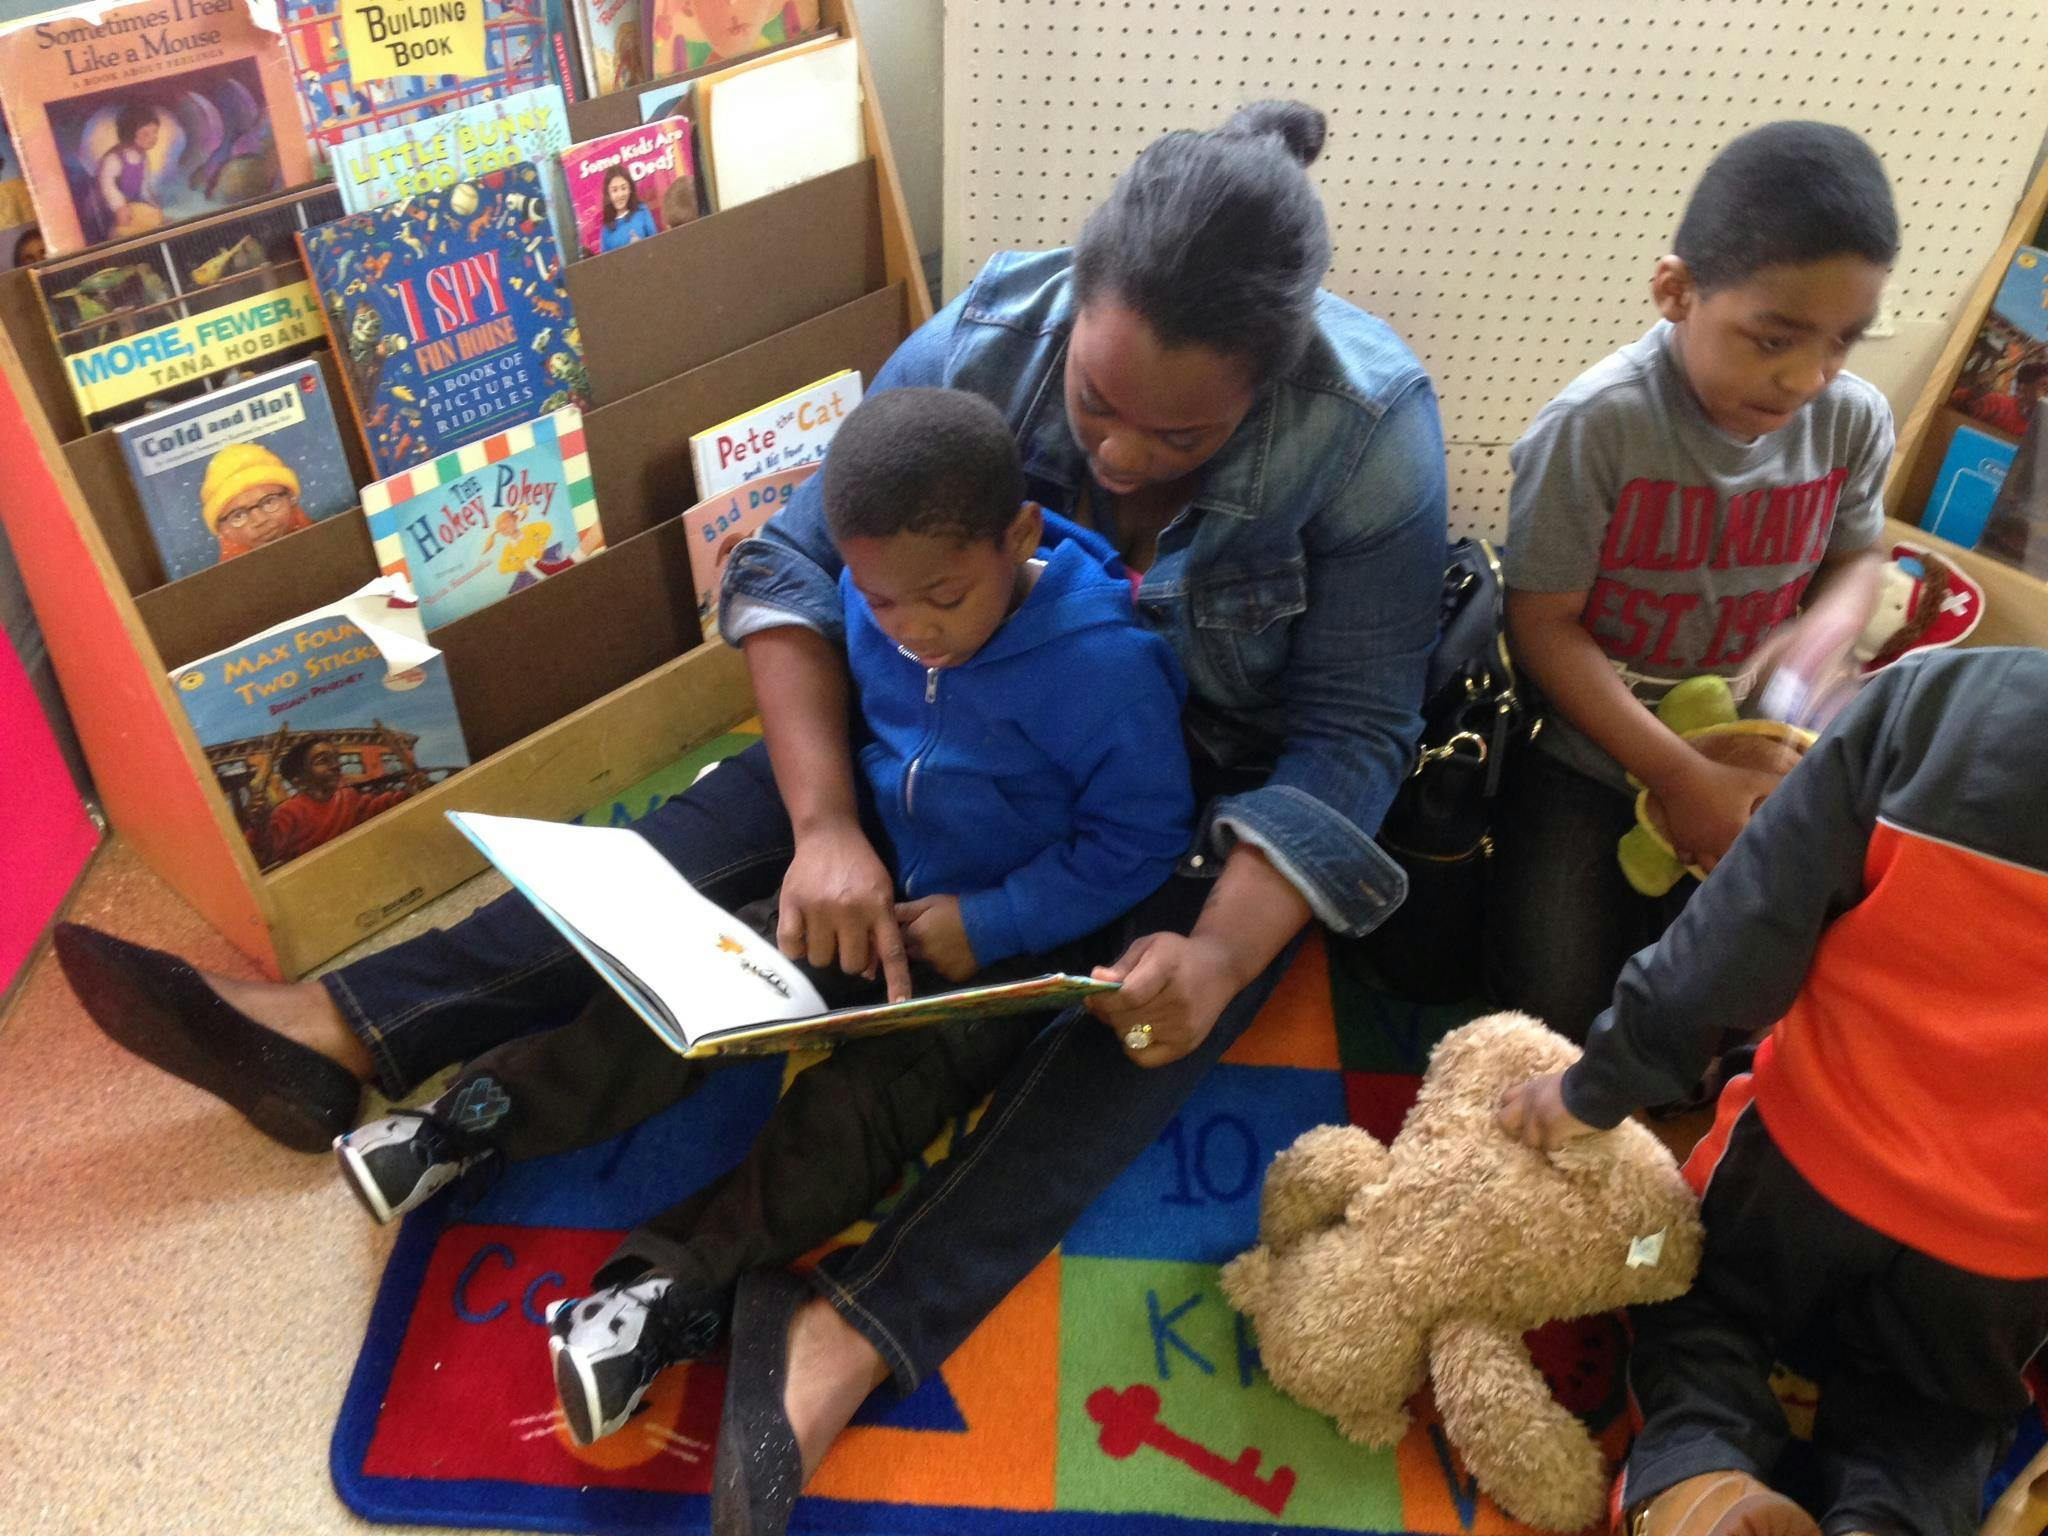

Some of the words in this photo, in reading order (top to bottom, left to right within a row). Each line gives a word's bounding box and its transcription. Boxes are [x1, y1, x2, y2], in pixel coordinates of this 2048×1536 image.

[35, 9, 170, 49] Sometimes
[173, 0, 185, 21] I
[189, 0, 235, 16] Feel
[64, 46, 119, 75] Like
[126, 49, 139, 63] a
[140, 28, 221, 59] Mouse
[351, 134, 448, 185] LITTLE
[457, 107, 552, 154] BUNNY
[395, 165, 458, 197] FOO
[465, 145, 523, 177] FOO
[579, 153, 621, 179] Some
[620, 136, 655, 163] Kids
[655, 127, 684, 148] Are
[629, 148, 676, 183] Deaf
[396, 279, 429, 344] I
[426, 249, 509, 334] SPY
[72, 325, 195, 388] MORE,
[197, 297, 303, 347] FEWER,
[150, 356, 214, 385] TANA
[225, 322, 306, 358] HOBAN
[414, 336, 459, 376] FUN
[456, 315, 518, 360] HOUSE
[427, 385, 440, 400] A
[443, 361, 497, 393] BOOK
[499, 352, 523, 371] OF
[431, 370, 529, 417] PICTURE
[142, 414, 202, 458] Cold
[209, 409, 244, 433] and
[249, 391, 294, 419] Hot
[436, 386, 534, 434] RIDDLES
[716, 427, 776, 470] Pete
[776, 411, 794, 429] the
[796, 391, 846, 432] Cat
[406, 495, 489, 563] Hokey
[492, 464, 558, 516] Pokey
[702, 498, 741, 542] Bad
[1600, 477, 1717, 571] OLD
[223, 645, 291, 684] MAX
[294, 624, 364, 653] FOUN
[235, 670, 298, 705] TWO
[1155, 1113, 1260, 1205] 10
